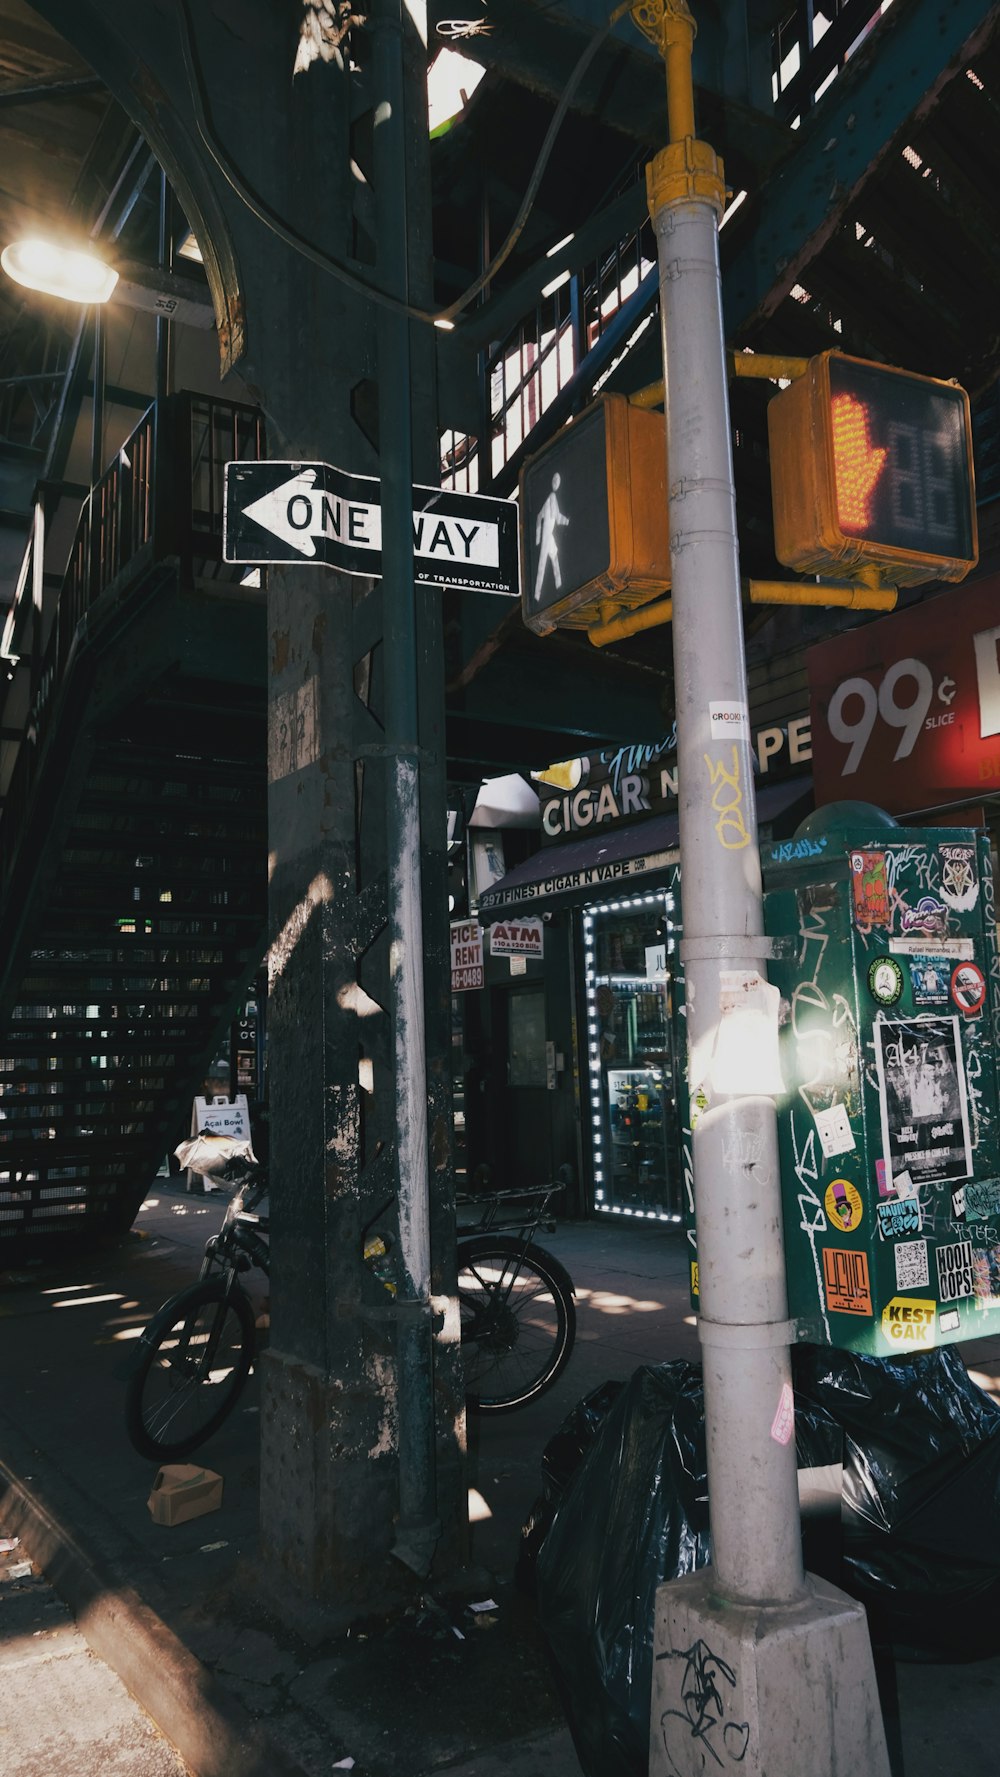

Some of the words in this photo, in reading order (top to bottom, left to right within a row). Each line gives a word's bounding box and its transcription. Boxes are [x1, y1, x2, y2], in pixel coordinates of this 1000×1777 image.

[287, 494, 370, 543] ONE
[418, 572, 430, 580] OF
[433, 574, 510, 591] TRANSPORTATION
[925, 712, 955, 730] SLICE
[542, 774, 648, 837] CIGAR
[756, 715, 813, 774] PE
[482, 894, 502, 907] 297
[503, 884, 542, 904] FINEST
[544, 872, 581, 893] CIGAR
[584, 870, 594, 884] N
[597, 861, 631, 880] VAPE
[451, 925, 479, 945] FICE
[492, 925, 542, 943] ATM
[455, 944, 481, 967] RENT
[451, 967, 482, 989] 46-0489
[889, 1305, 935, 1325] KEST
[890, 1322, 928, 1341] GAK
